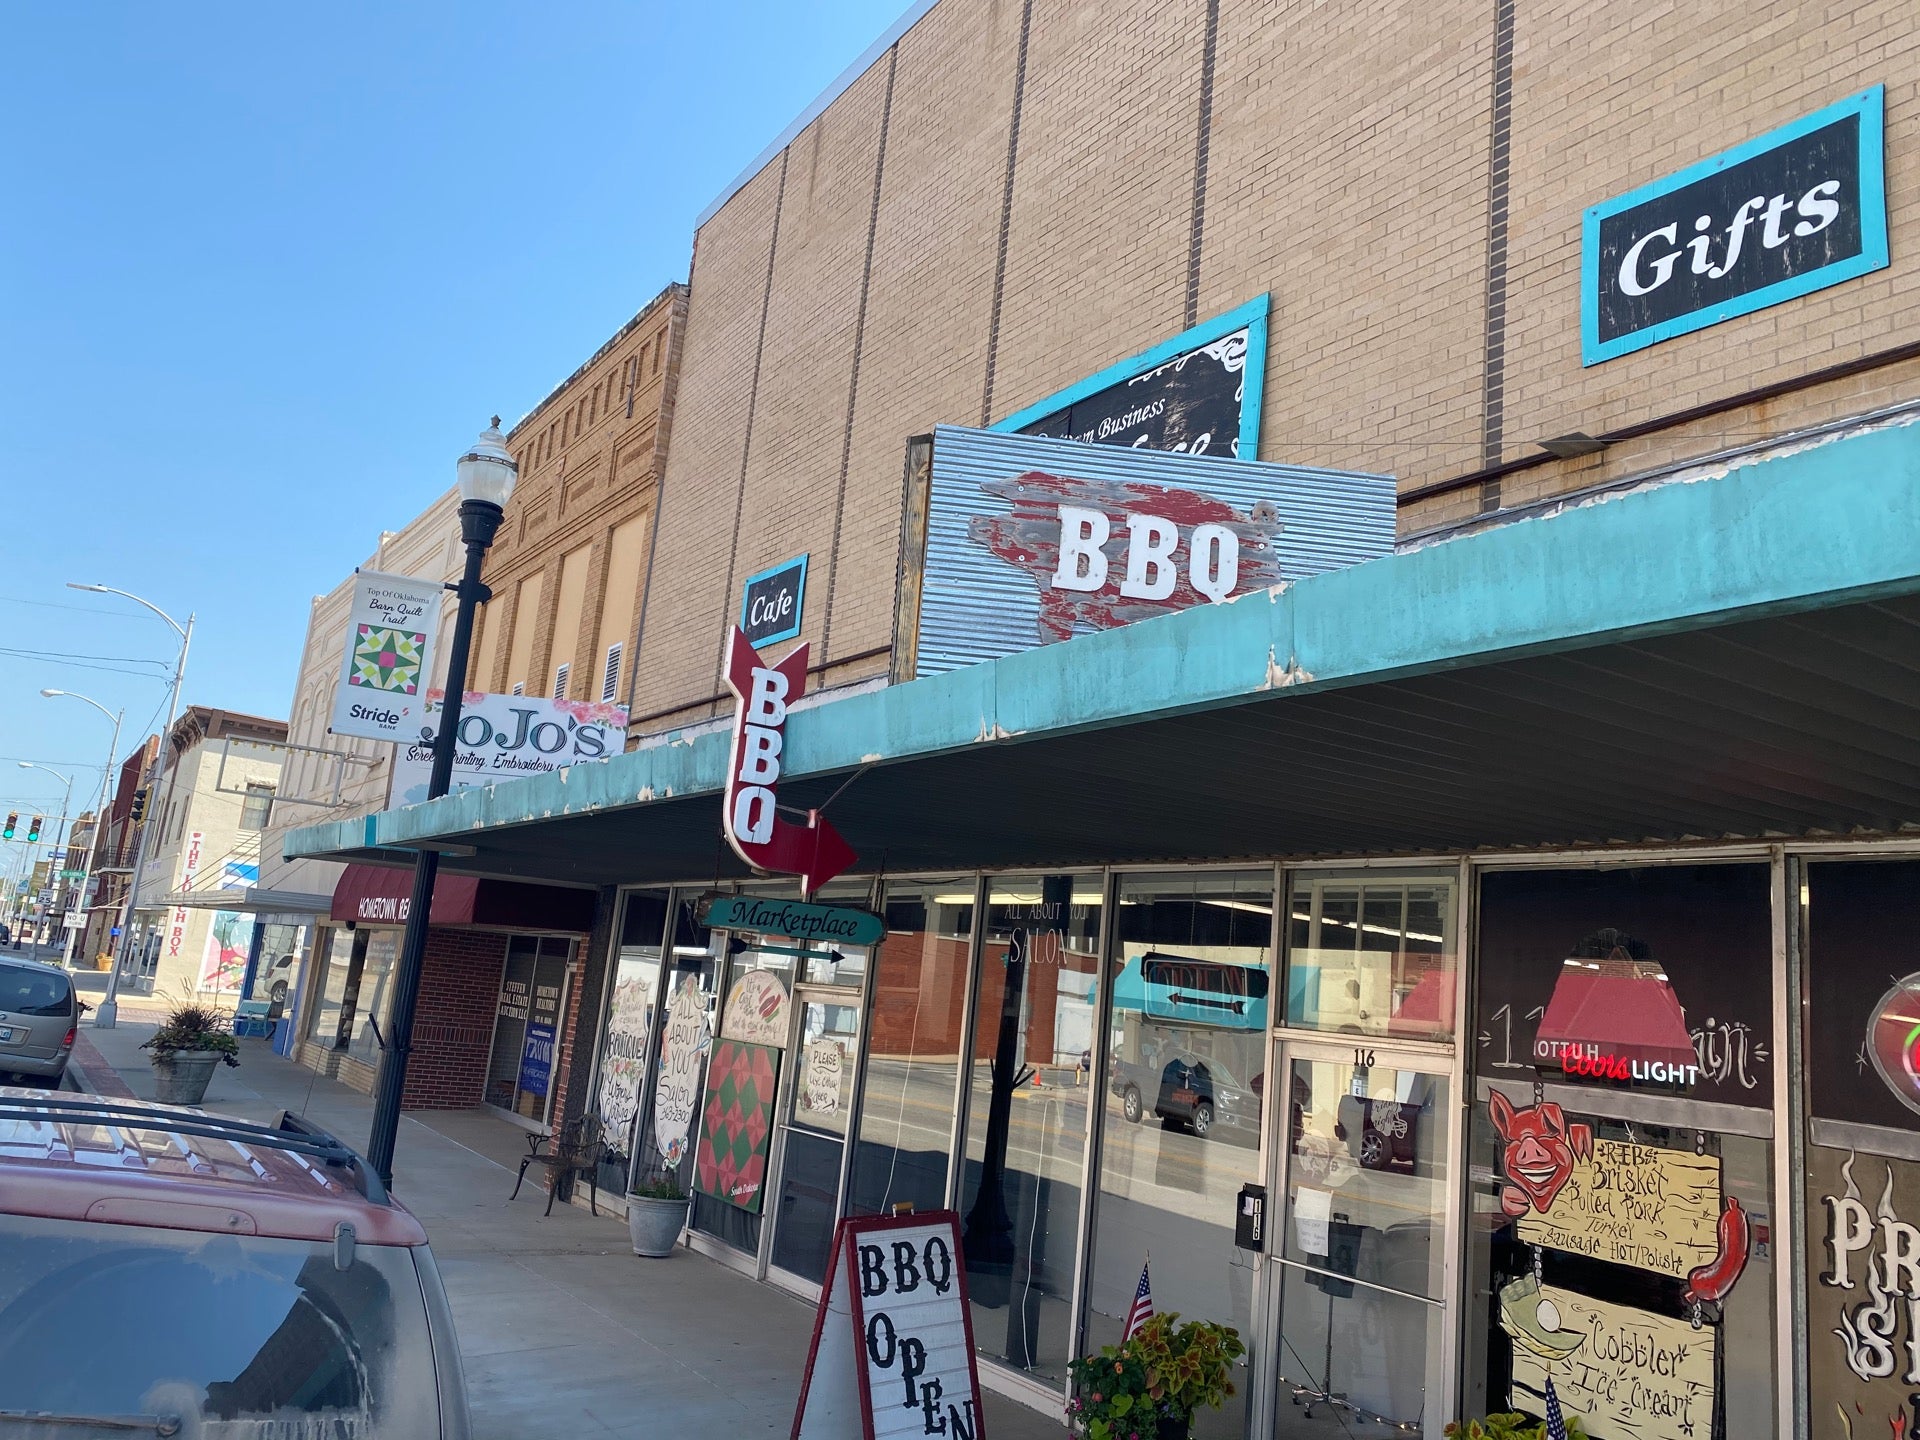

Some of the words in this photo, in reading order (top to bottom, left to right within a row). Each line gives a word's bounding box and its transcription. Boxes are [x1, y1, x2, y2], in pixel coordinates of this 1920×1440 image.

[1618, 180, 1840, 296] Gifts
[1098, 398, 1165, 440] Business
[1051, 504, 1239, 604] BBQ
[367, 587, 380, 597] Top
[382, 590, 392, 598] Of
[393, 592, 429, 605] Oklahoma
[369, 598, 395, 612] Barn
[397, 603, 422, 616] Quilt
[750, 588, 792, 626] Cafe
[382, 612, 407, 625] Trail
[350, 704, 399, 724] Stride
[406, 745, 436, 762] Scree
[733, 666, 789, 845] BBQ
[187, 841, 200, 869] THE
[39, 896, 51, 904] 25
[175, 874, 192, 923] LUCH
[1004, 903, 1021, 919] ALL
[1028, 902, 1062, 920] ABOUT
[1070, 902, 1088, 920] YOU
[728, 900, 858, 937] Marketplace
[169, 927, 183, 957] BOX
[1010, 927, 1070, 964] SALON
[677, 1001, 694, 1020] ALL
[668, 1022, 700, 1045] ABOUT
[671, 1049, 691, 1076] YOU
[813, 1050, 837, 1066] PLEASE
[1353, 1048, 1375, 1067] 116
[1560, 1044, 1630, 1080] Coors
[1632, 1059, 1700, 1085] LIGHT
[656, 1075, 695, 1109] Salon
[1605, 1142, 1653, 1166] RIBS
[1590, 1161, 1669, 1202] Brisket
[1566, 1184, 1615, 1218] Pulled
[859, 1236, 951, 1297] BBQ
[1593, 1320, 1684, 1378] Cobbler
[867, 1312, 975, 1440] OPEN
[1571, 1361, 1619, 1401] Ice
[1631, 1380, 1695, 1427] Cream
